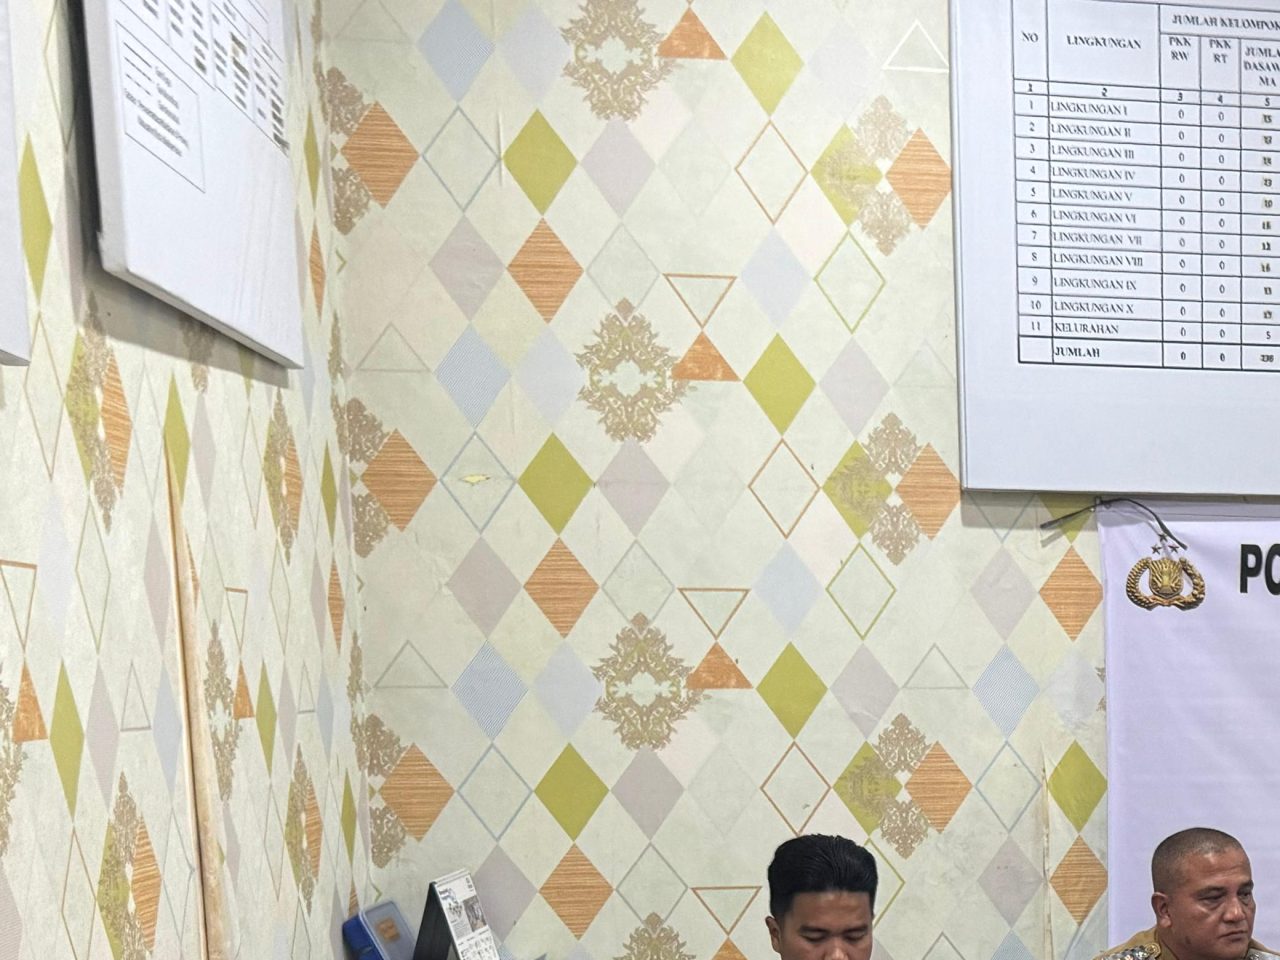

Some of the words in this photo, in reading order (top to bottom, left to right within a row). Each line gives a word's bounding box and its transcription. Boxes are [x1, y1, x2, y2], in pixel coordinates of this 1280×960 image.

[1172, 14, 1219, 27] JUMLAH
[1021, 31, 1039, 43] NO
[1067, 35, 1141, 49] LINGKUNGAN
[1169, 36, 1191, 47] PKK
[1209, 38, 1231, 49] PKK
[1172, 51, 1189, 61] RW
[1214, 53, 1228, 64] RT
[1259, 76, 1277, 87] MA
[1051, 101, 1121, 115] LINGKUNGAN
[1051, 123, 1121, 137] LINGKUNGAN
[1052, 145, 1121, 158] LINGKUNGAN
[1052, 167, 1122, 180] LINGKUNGAN
[1052, 188, 1122, 201] LINGKUNGAN
[1052, 210, 1123, 223] LINGKUNGAN
[1053, 232, 1123, 245] LINGKUNGAN
[1054, 253, 1123, 266] LINGKUNGAN
[1054, 277, 1123, 290] LINGKUNGAN
[1054, 301, 1124, 313] LINGKUNGAN
[1055, 323, 1119, 334] KELURAHAN
[1055, 347, 1100, 357] JUMLAH
